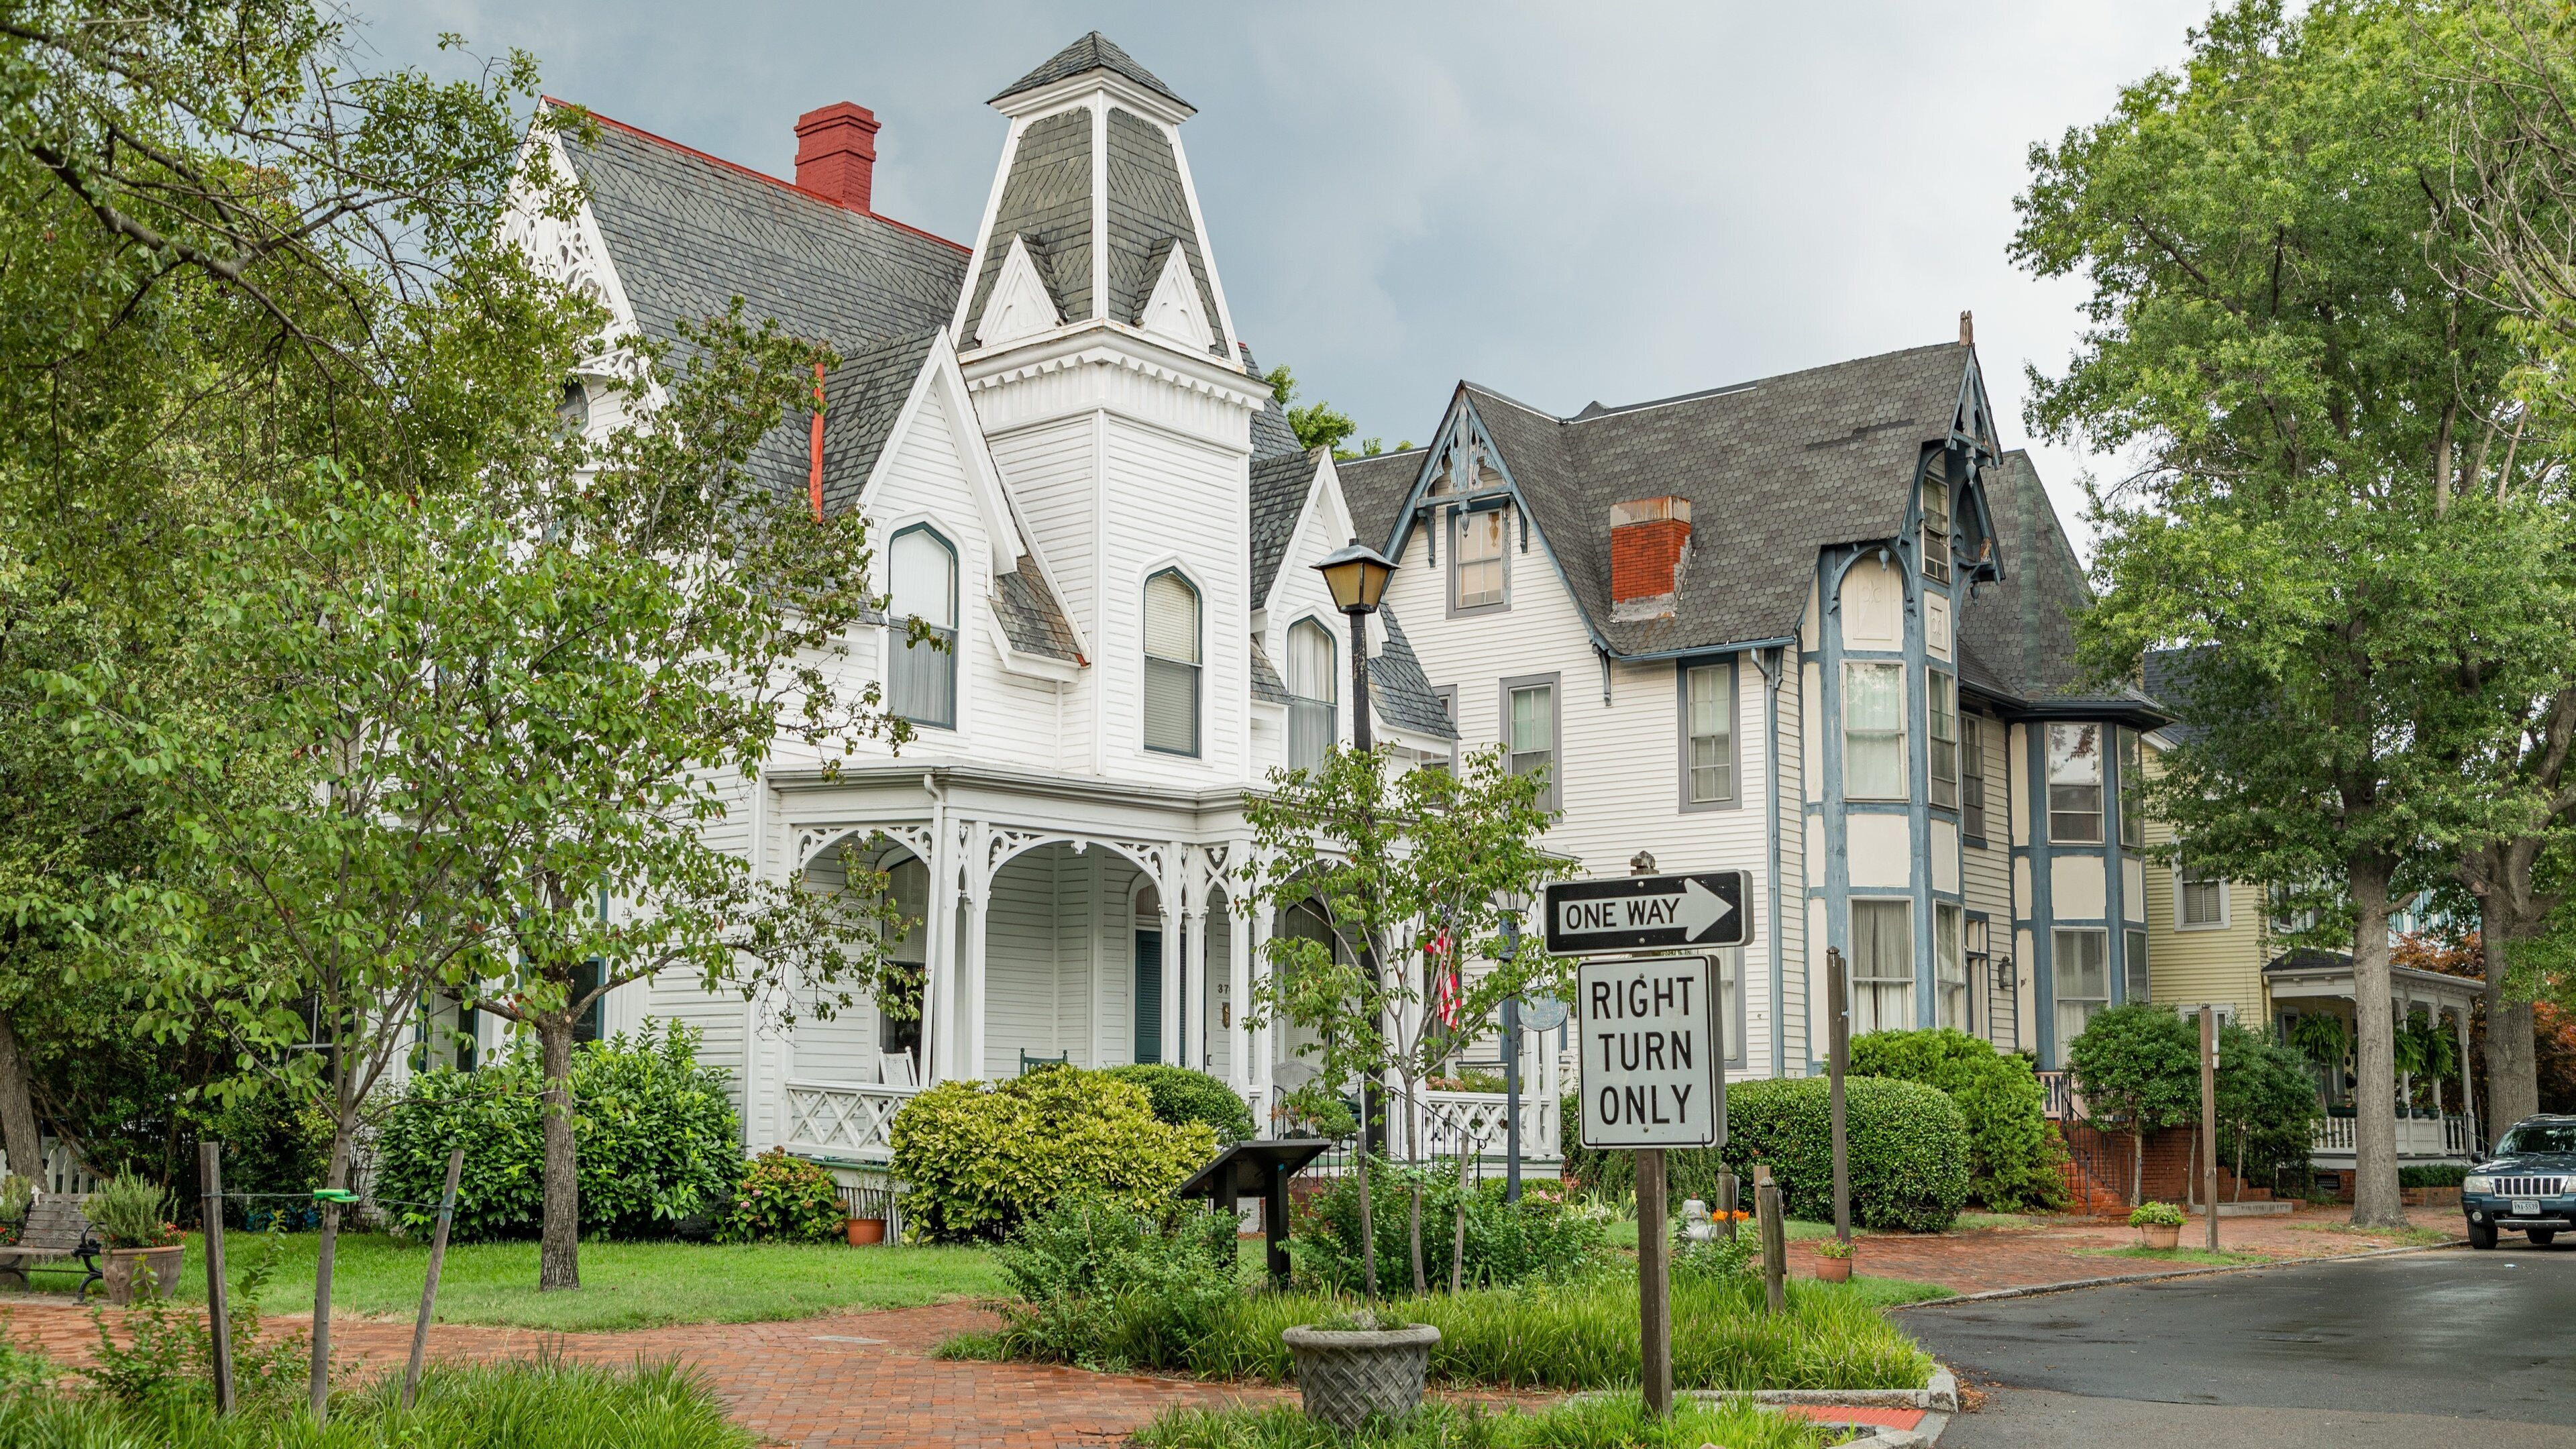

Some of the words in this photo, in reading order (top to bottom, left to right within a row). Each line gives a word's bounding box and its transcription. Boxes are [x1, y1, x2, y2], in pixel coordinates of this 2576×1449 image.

[1566, 902, 1617, 930] ONE
[1627, 898, 1680, 926] WAY
[1218, 983, 1230, 994] 37
[1592, 977, 1695, 1020] RIGHT
[1598, 1030, 1693, 1072] TURN
[1600, 1084, 1693, 1125] ONLY
